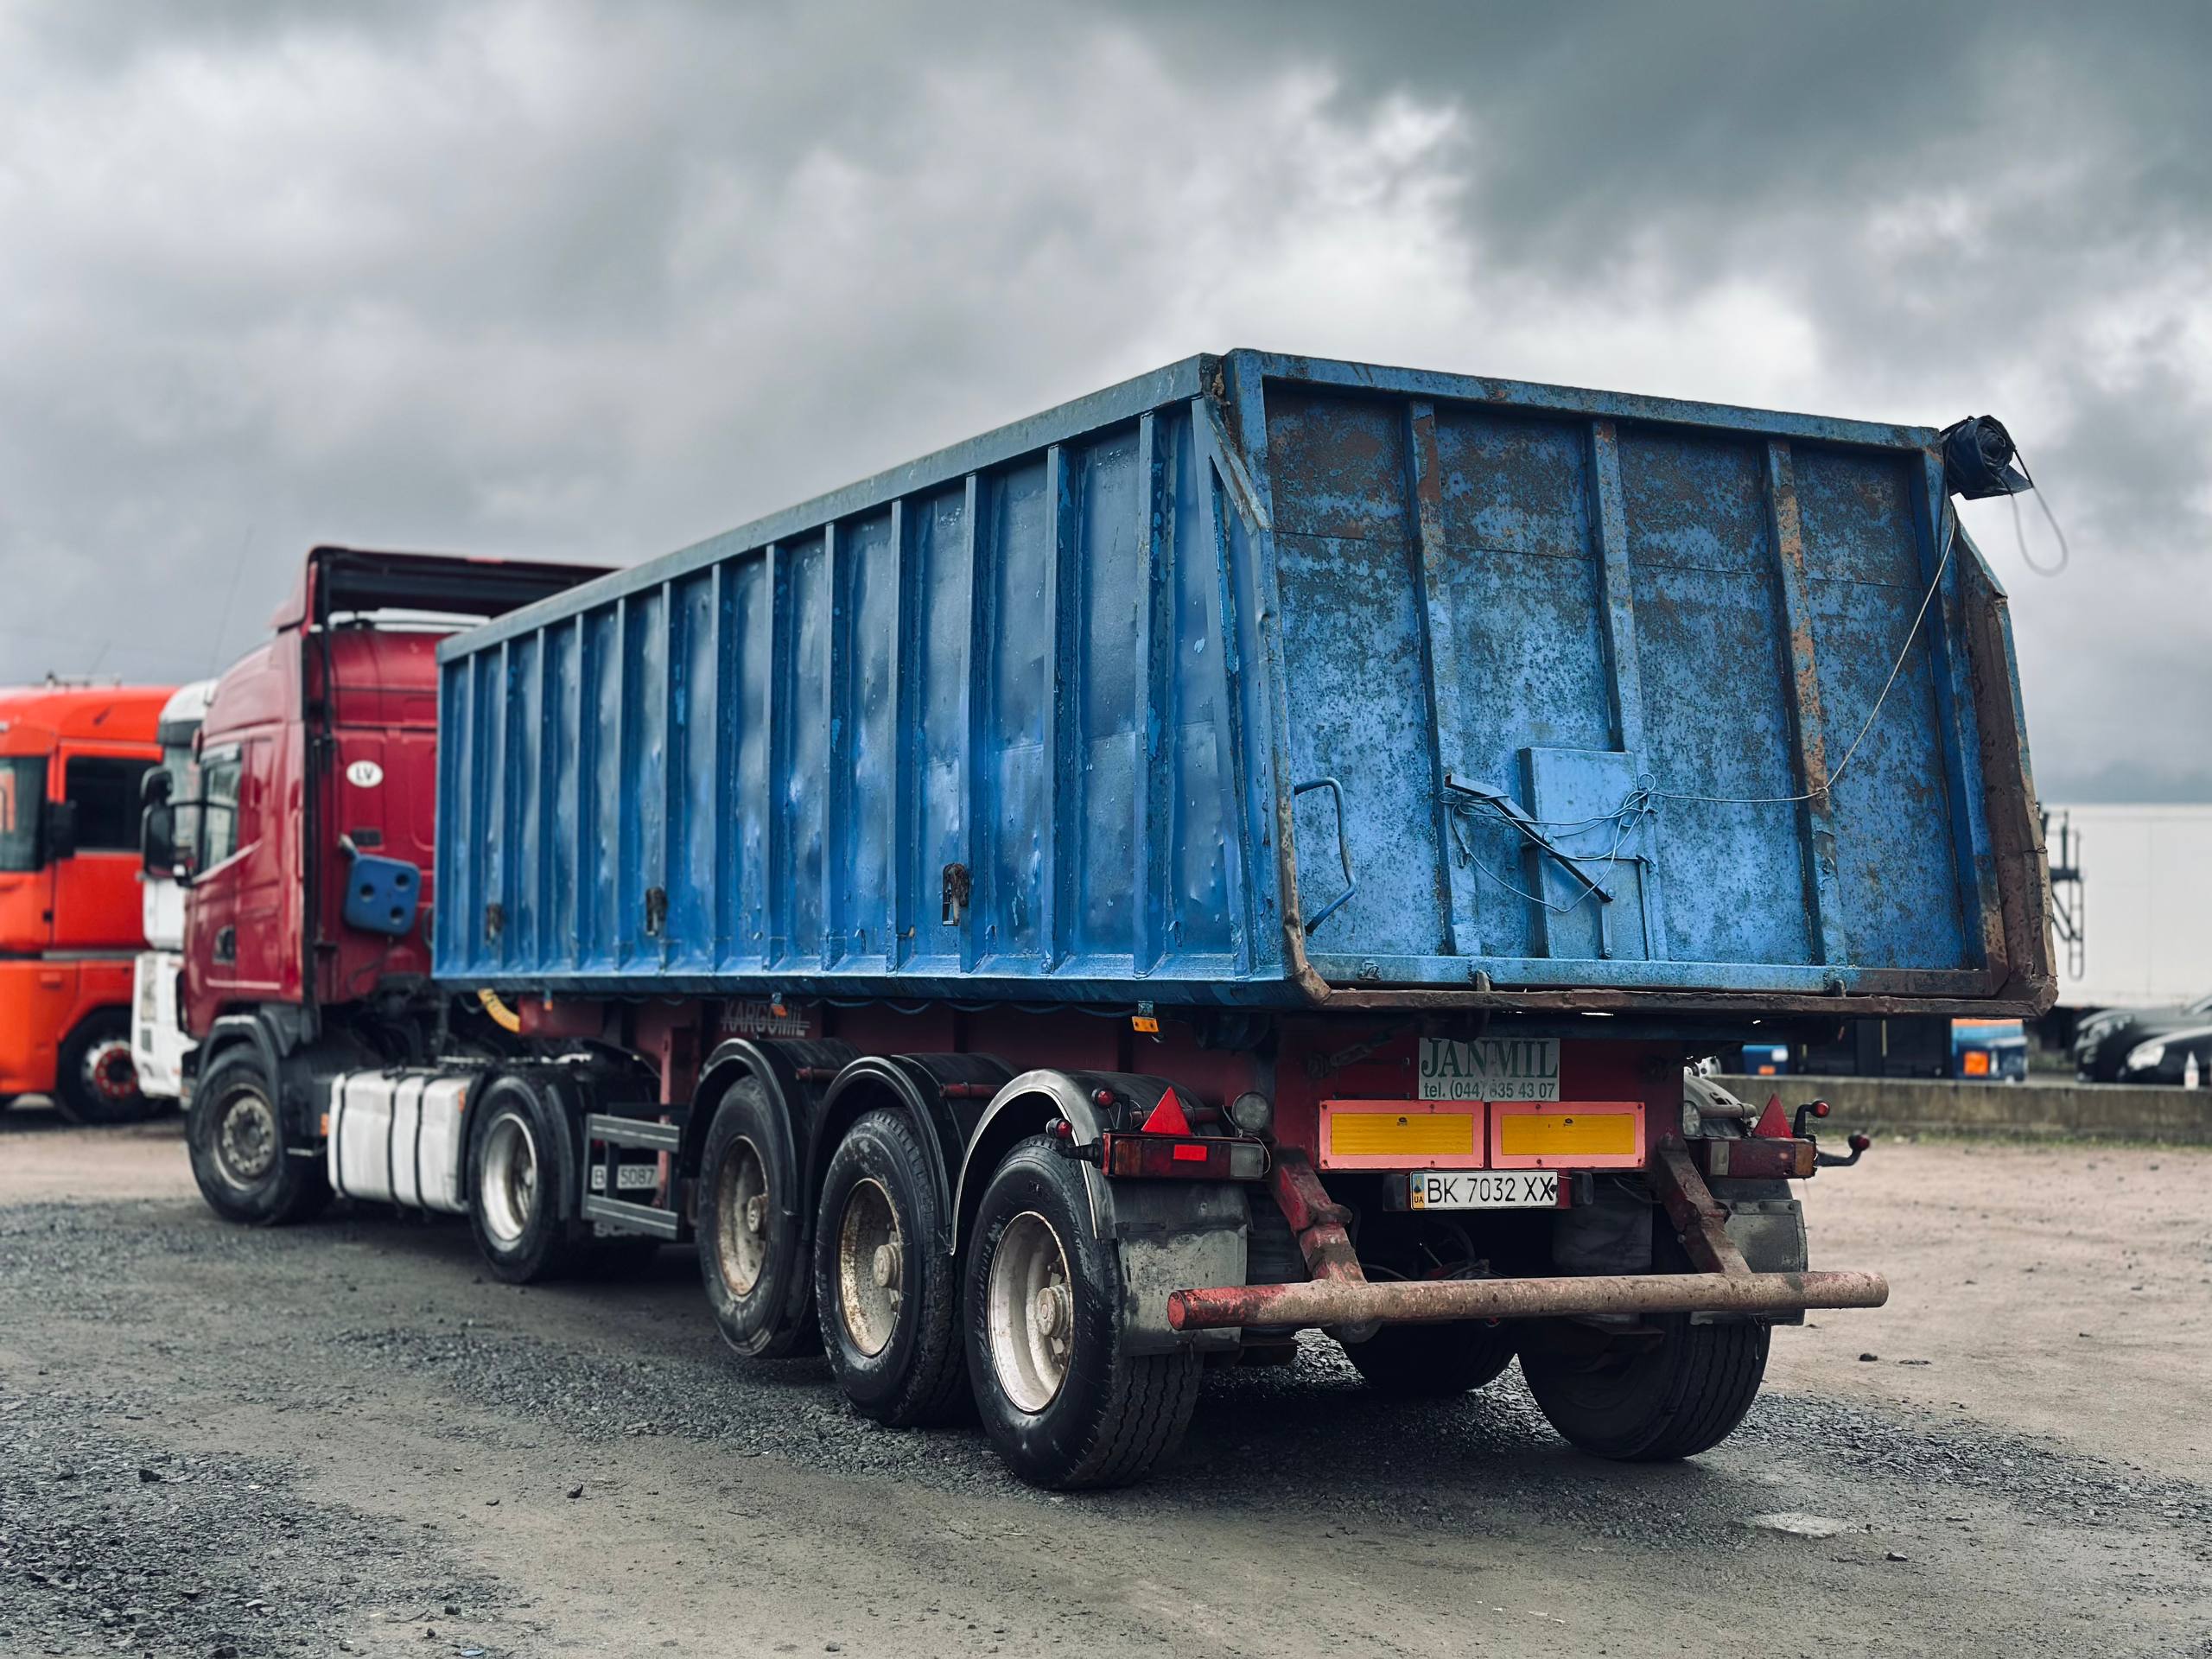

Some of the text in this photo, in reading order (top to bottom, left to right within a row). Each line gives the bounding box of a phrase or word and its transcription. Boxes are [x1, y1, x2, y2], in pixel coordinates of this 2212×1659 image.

[355, 766, 374, 781] LV
[1421, 1038, 1558, 1077] JANMIL
[1424, 1081, 1446, 1097] tel.
[1450, 1080, 1484, 1100] (044)
[1518, 1083, 1535, 1098] 43
[1539, 1083, 1555, 1098] 07
[620, 1168, 655, 1185] 5087
[1427, 1176, 1554, 1203] BK 7032 XX
